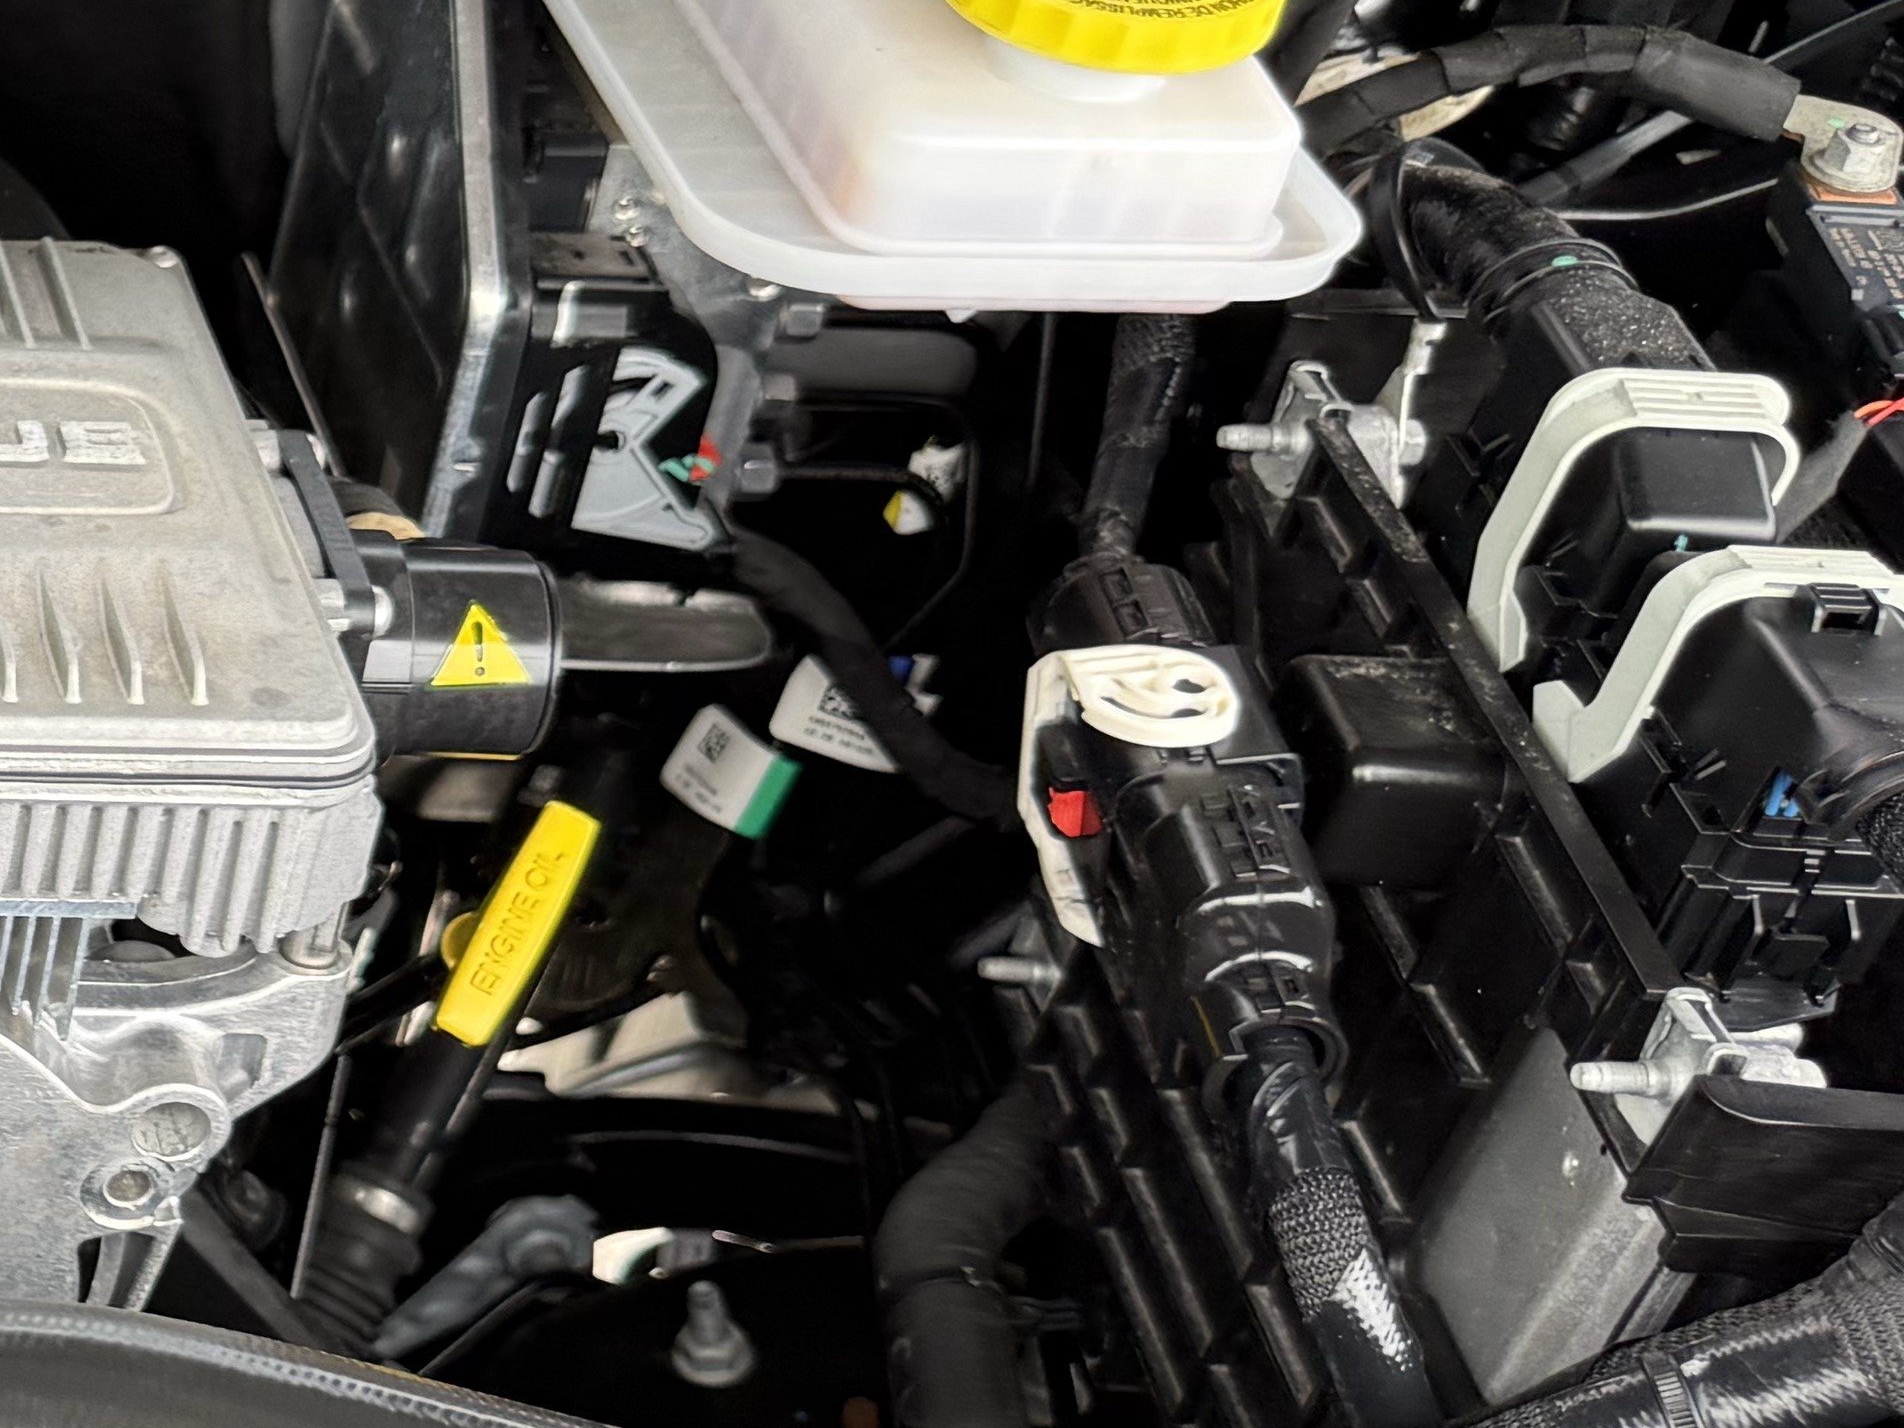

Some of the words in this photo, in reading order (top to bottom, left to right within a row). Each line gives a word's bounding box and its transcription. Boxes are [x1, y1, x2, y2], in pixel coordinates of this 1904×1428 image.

[1180, 3, 1216, 18] DE
[469, 891, 540, 996] ENGINE
[525, 852, 566, 890] OIL
